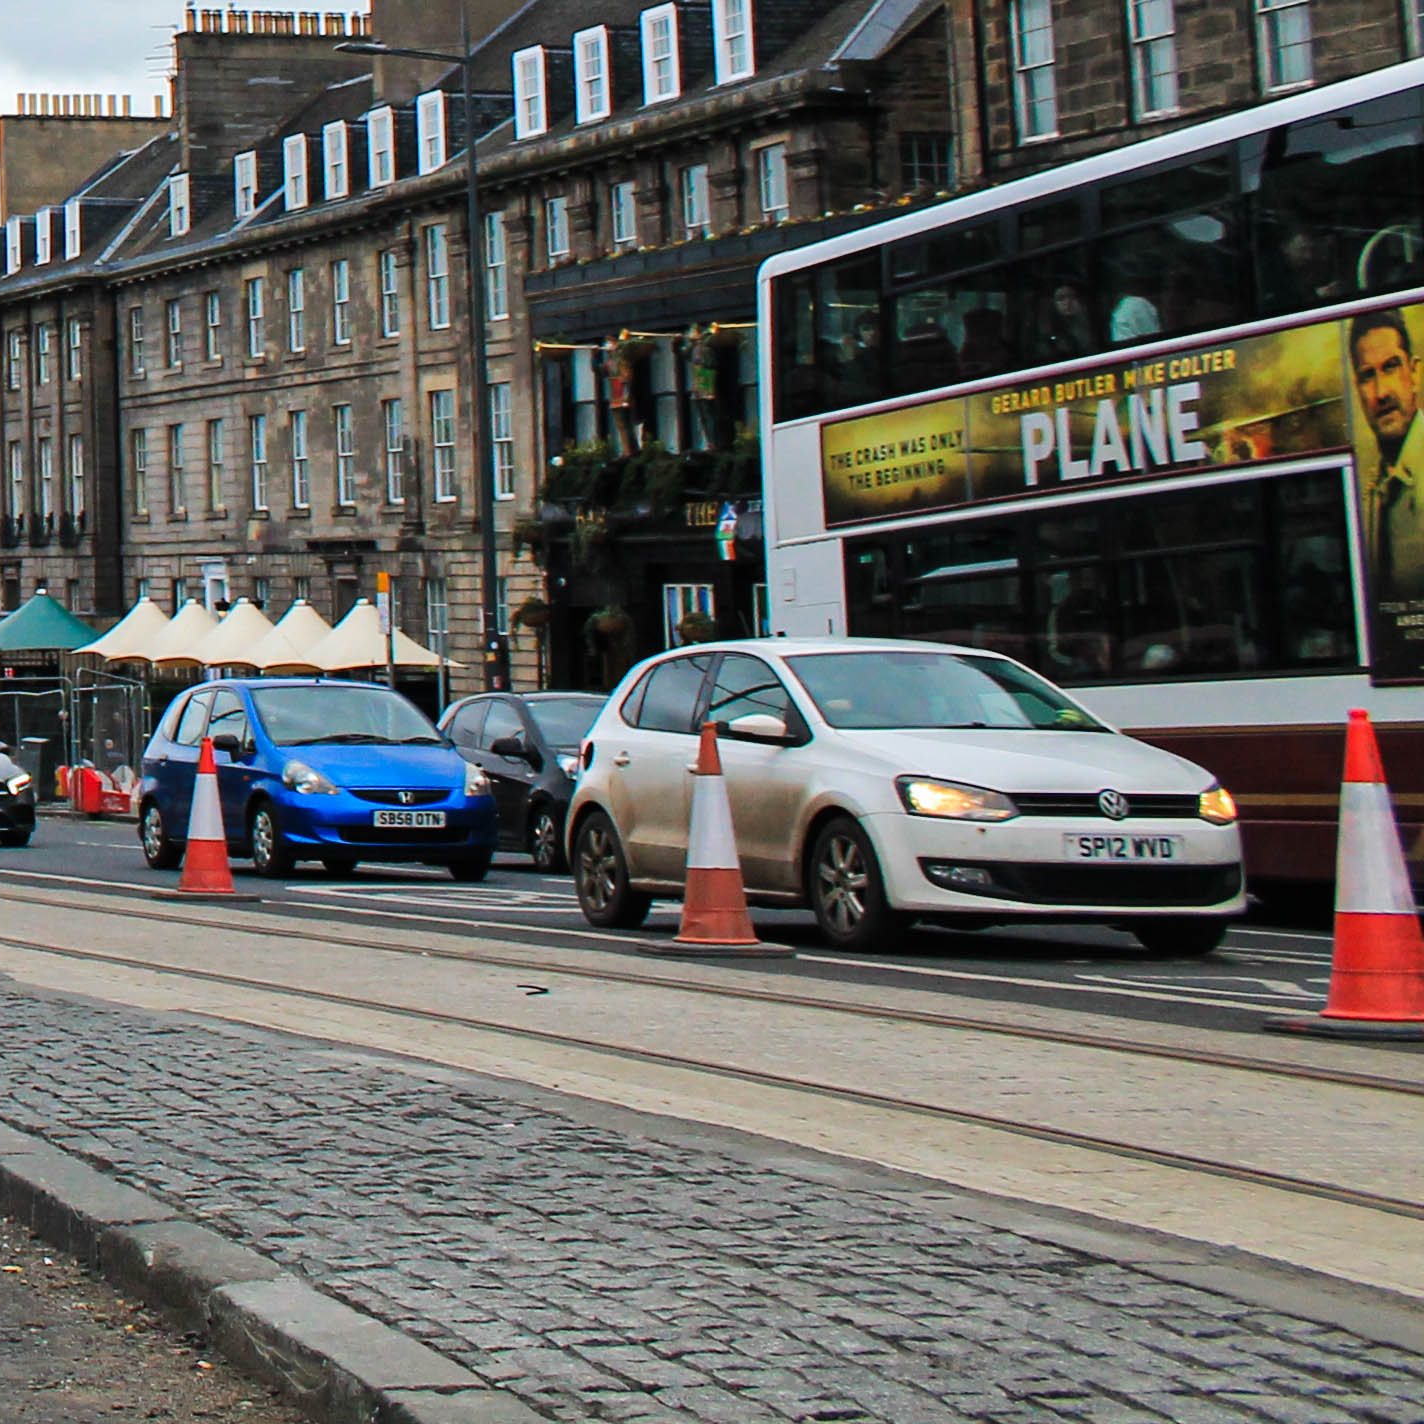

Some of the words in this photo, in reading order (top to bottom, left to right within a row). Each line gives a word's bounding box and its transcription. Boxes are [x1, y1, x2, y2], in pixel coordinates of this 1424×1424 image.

[992, 387, 1051, 414] GERARD
[1055, 374, 1116, 403] BUTLER
[1123, 362, 1166, 389] MIKE
[1169, 349, 1236, 378] COLTER
[830, 452, 852, 470] THE
[856, 443, 896, 466] CRASH
[899, 437, 926, 457] WAS
[931, 430, 965, 451] ONLY
[1021, 381, 1207, 487] PLANE
[849, 471, 872, 489] THE
[875, 458, 945, 487] BEGINNING
[379, 812, 412, 826] SB58
[1078, 836, 1127, 858] SP12
